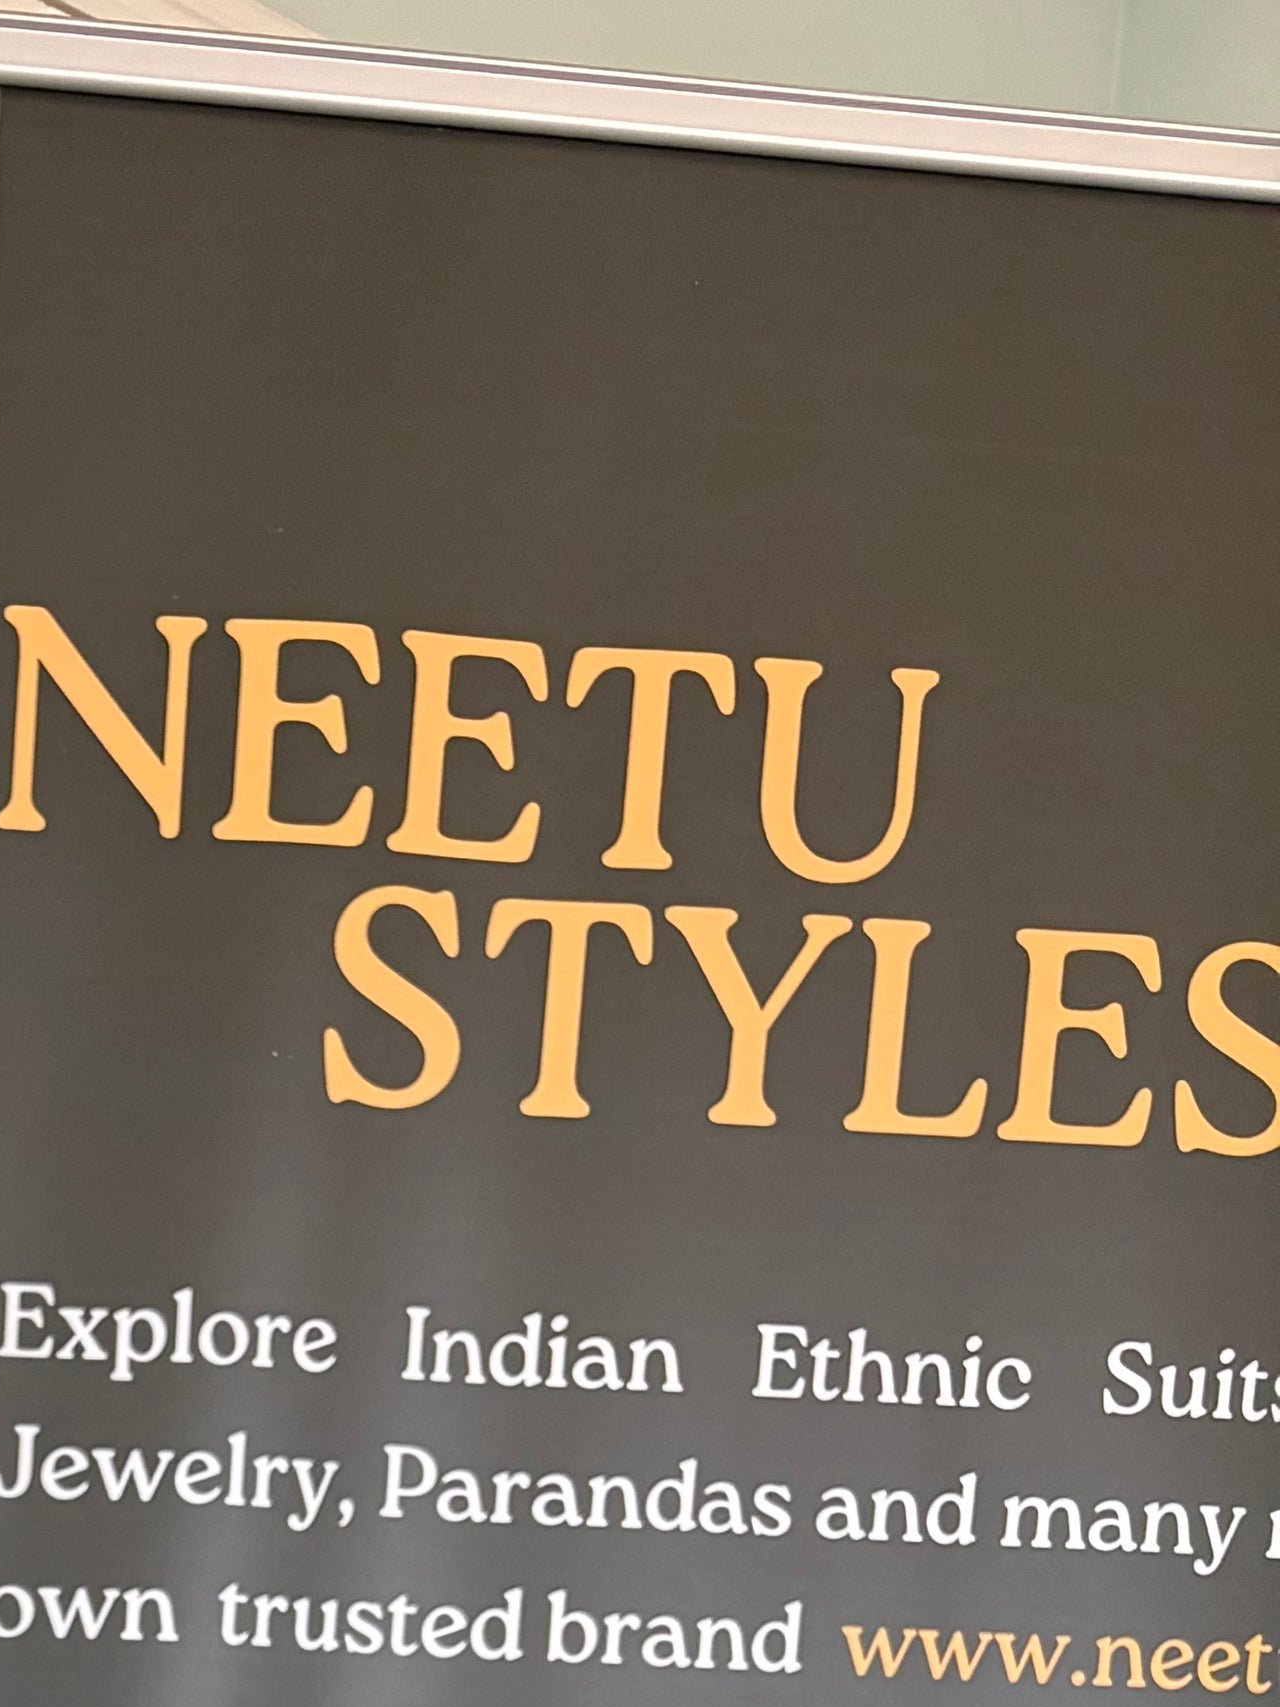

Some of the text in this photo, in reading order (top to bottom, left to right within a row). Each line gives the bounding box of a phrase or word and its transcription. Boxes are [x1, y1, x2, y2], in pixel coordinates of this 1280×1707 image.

[323, 884, 1280, 1157] STYLES
[401, 1306, 684, 1394] Indian
[751, 1323, 1033, 1411] Ethnic
[1103, 1341, 1280, 1424] Suit
[378, 1443, 793, 1538] Parandas
[814, 1471, 979, 1546] and
[999, 1495, 1247, 1576] many
[217, 1582, 525, 1662] trusted
[546, 1589, 804, 1675] brand
[841, 1624, 1280, 1696] www.neet
